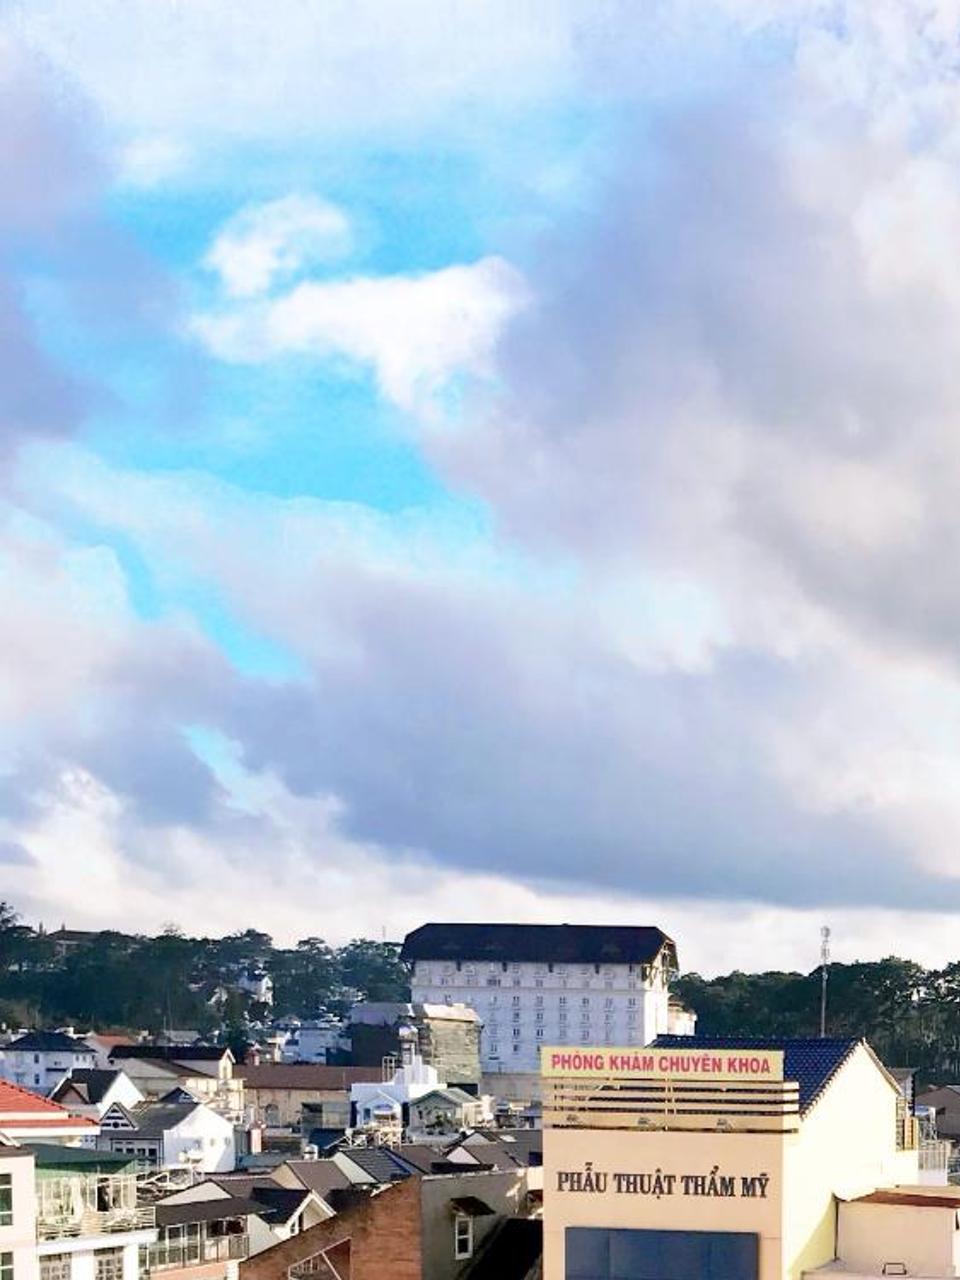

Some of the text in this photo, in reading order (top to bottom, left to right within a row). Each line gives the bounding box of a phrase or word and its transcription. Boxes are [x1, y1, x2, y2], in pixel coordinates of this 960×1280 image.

[658, 1053, 722, 1074] CHUYÊN
[727, 1057, 771, 1074] KHOA
[557, 1162, 770, 1199] PHẪU THUẬT THẨM MỸ
